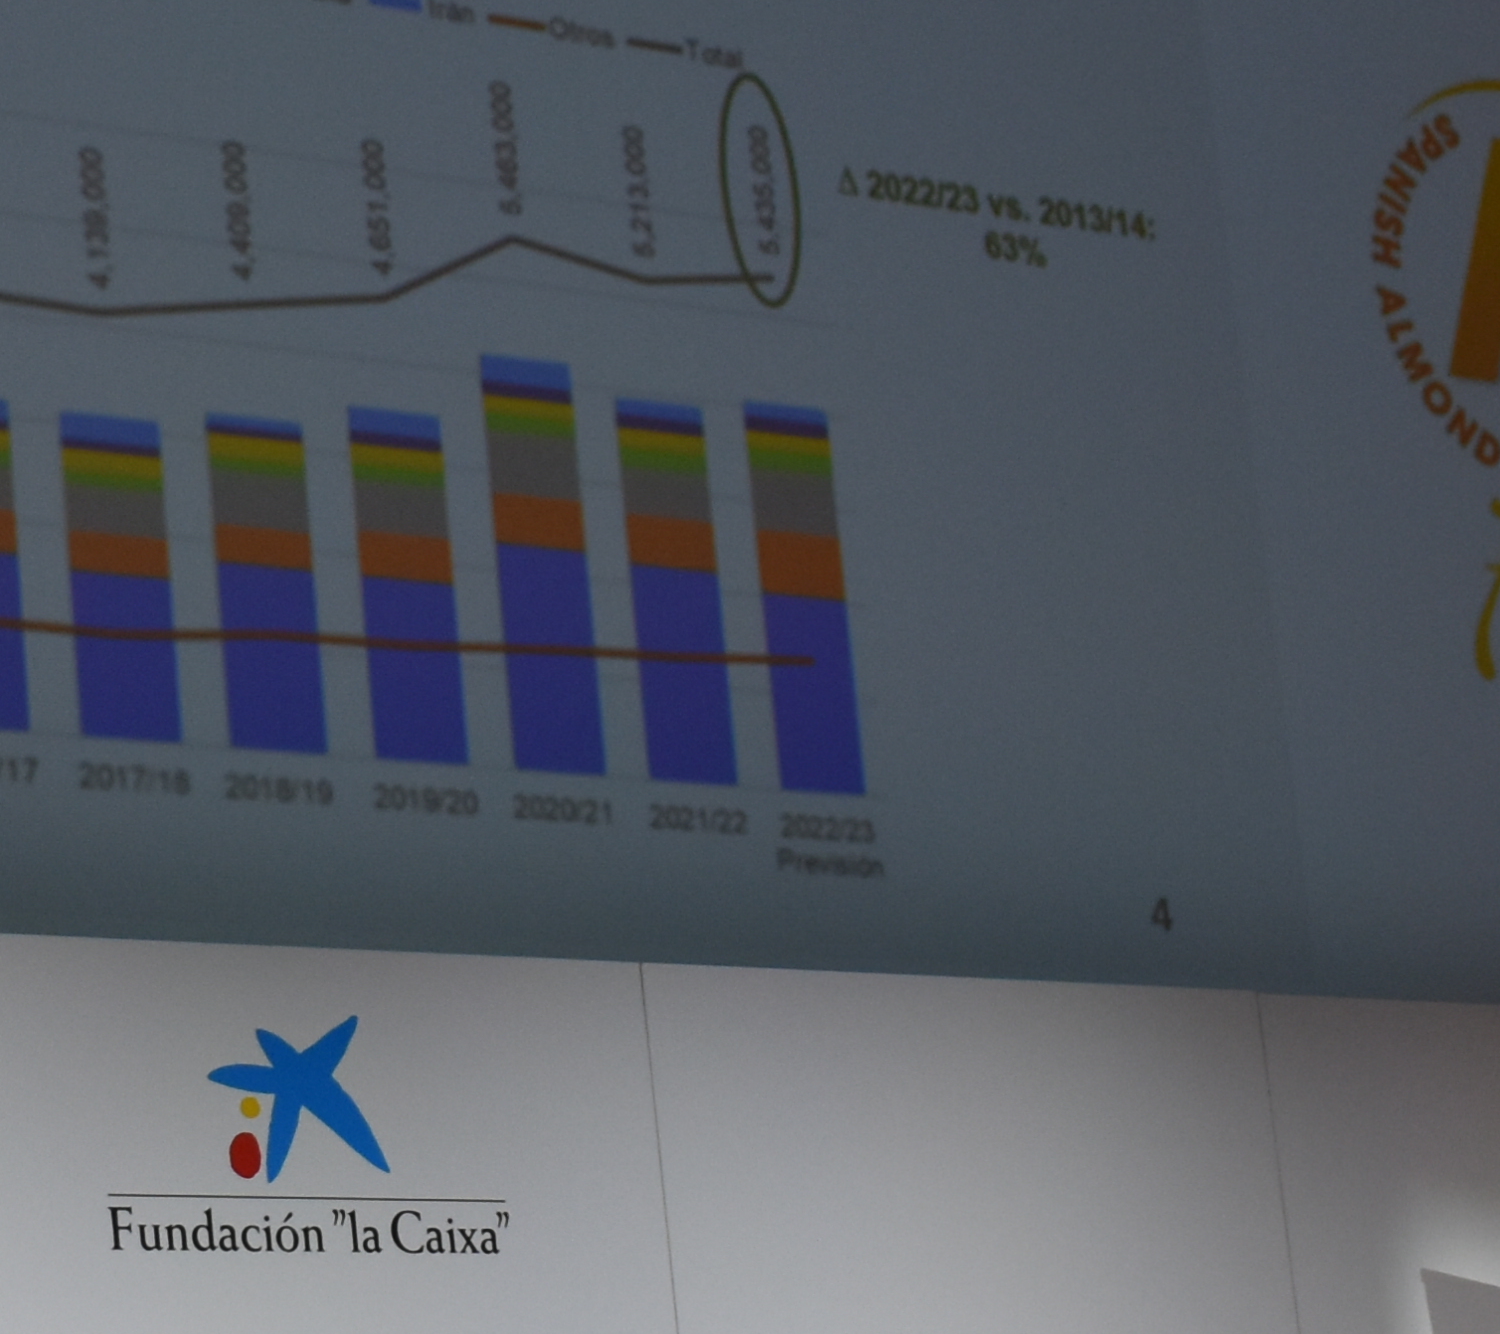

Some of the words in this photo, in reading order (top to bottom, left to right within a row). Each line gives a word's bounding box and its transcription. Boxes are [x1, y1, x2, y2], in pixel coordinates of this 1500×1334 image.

[551, 18, 615, 48] Otros
[685, 38, 744, 67] Total
[866, 169, 980, 215] 2022/23
[987, 193, 1031, 221] vs.
[1038, 196, 1156, 241] 2013/14:
[1371, 113, 1460, 268] SPANISH
[984, 230, 1047, 268] 63%
[1376, 283, 1500, 467] ALMOND
[79, 762, 189, 796] 2017/18
[225, 772, 333, 807] 2018/19
[373, 782, 479, 816] 2019/20
[512, 792, 614, 826] 2020/21
[649, 803, 748, 836] 2021/22
[780, 813, 877, 843] 2022/23
[1150, 895, 1172, 933] 4
[108, 1206, 325, 1252] Fundación
